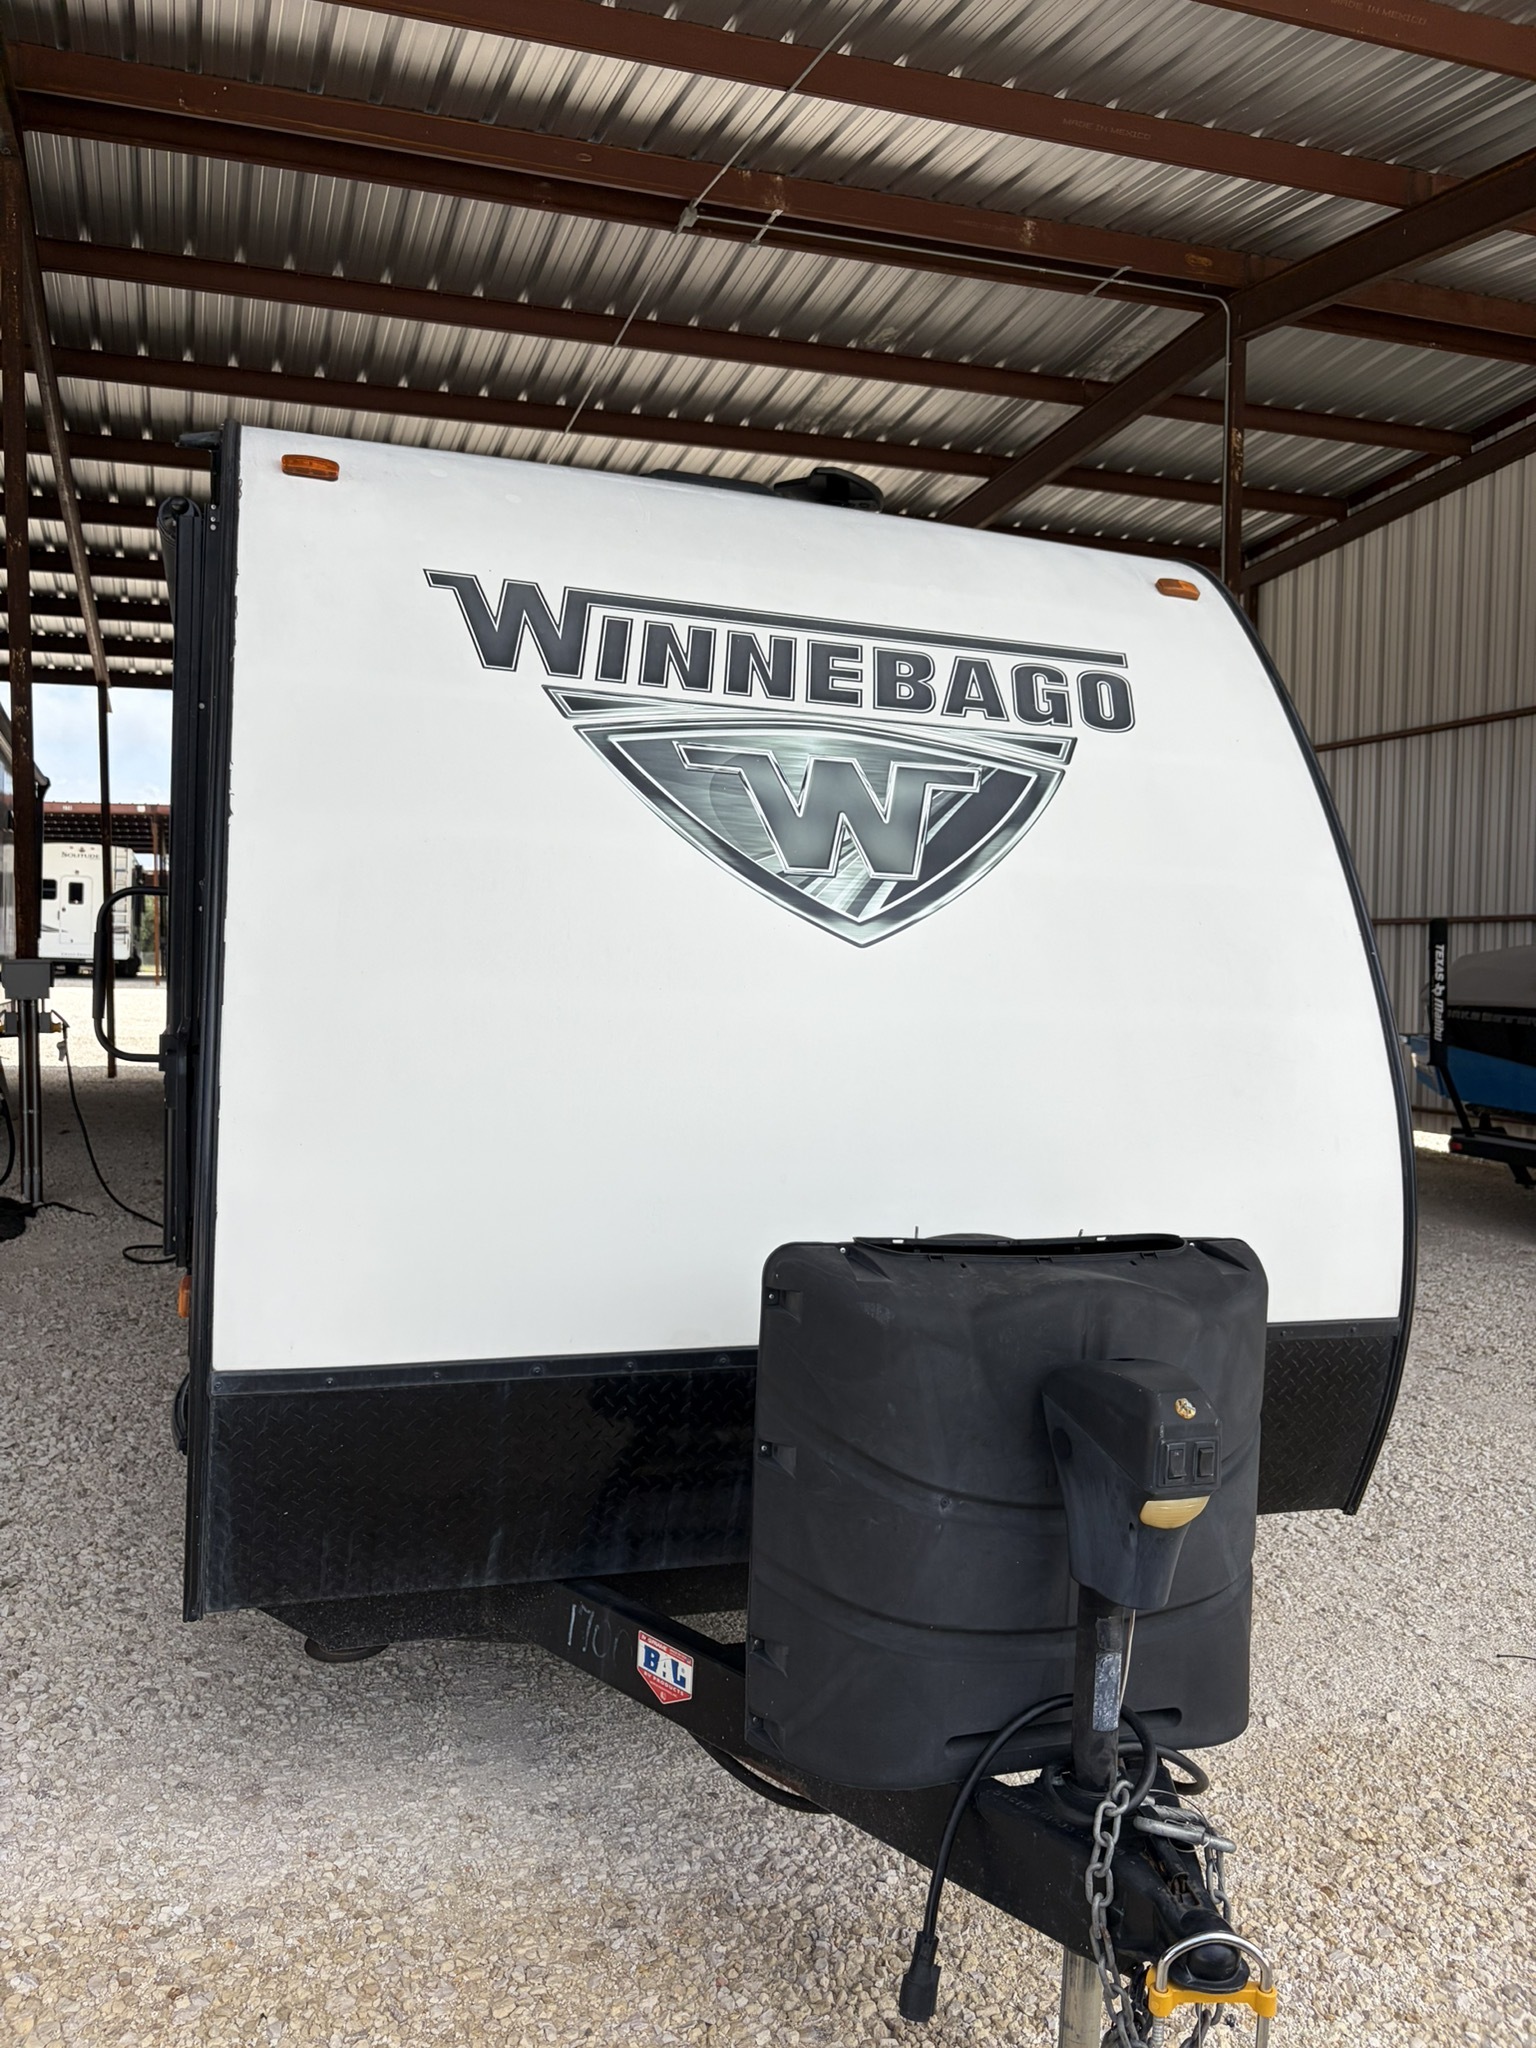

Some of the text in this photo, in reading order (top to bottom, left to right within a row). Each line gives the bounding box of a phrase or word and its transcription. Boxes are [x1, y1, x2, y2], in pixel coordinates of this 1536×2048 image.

[1366, 4, 1381, 15] IN
[1381, 8, 1428, 26] MEXICO
[1062, 117, 1151, 141] MADE IN MEXICO
[422, 568, 1137, 734] WINNEBAGO
[674, 740, 982, 881] W
[1434, 943, 1445, 982] TEXAS
[643, 1644, 686, 1689] BAL
[643, 1670, 652, 1678] RV
[652, 1675, 685, 1697] PRODUCTS
